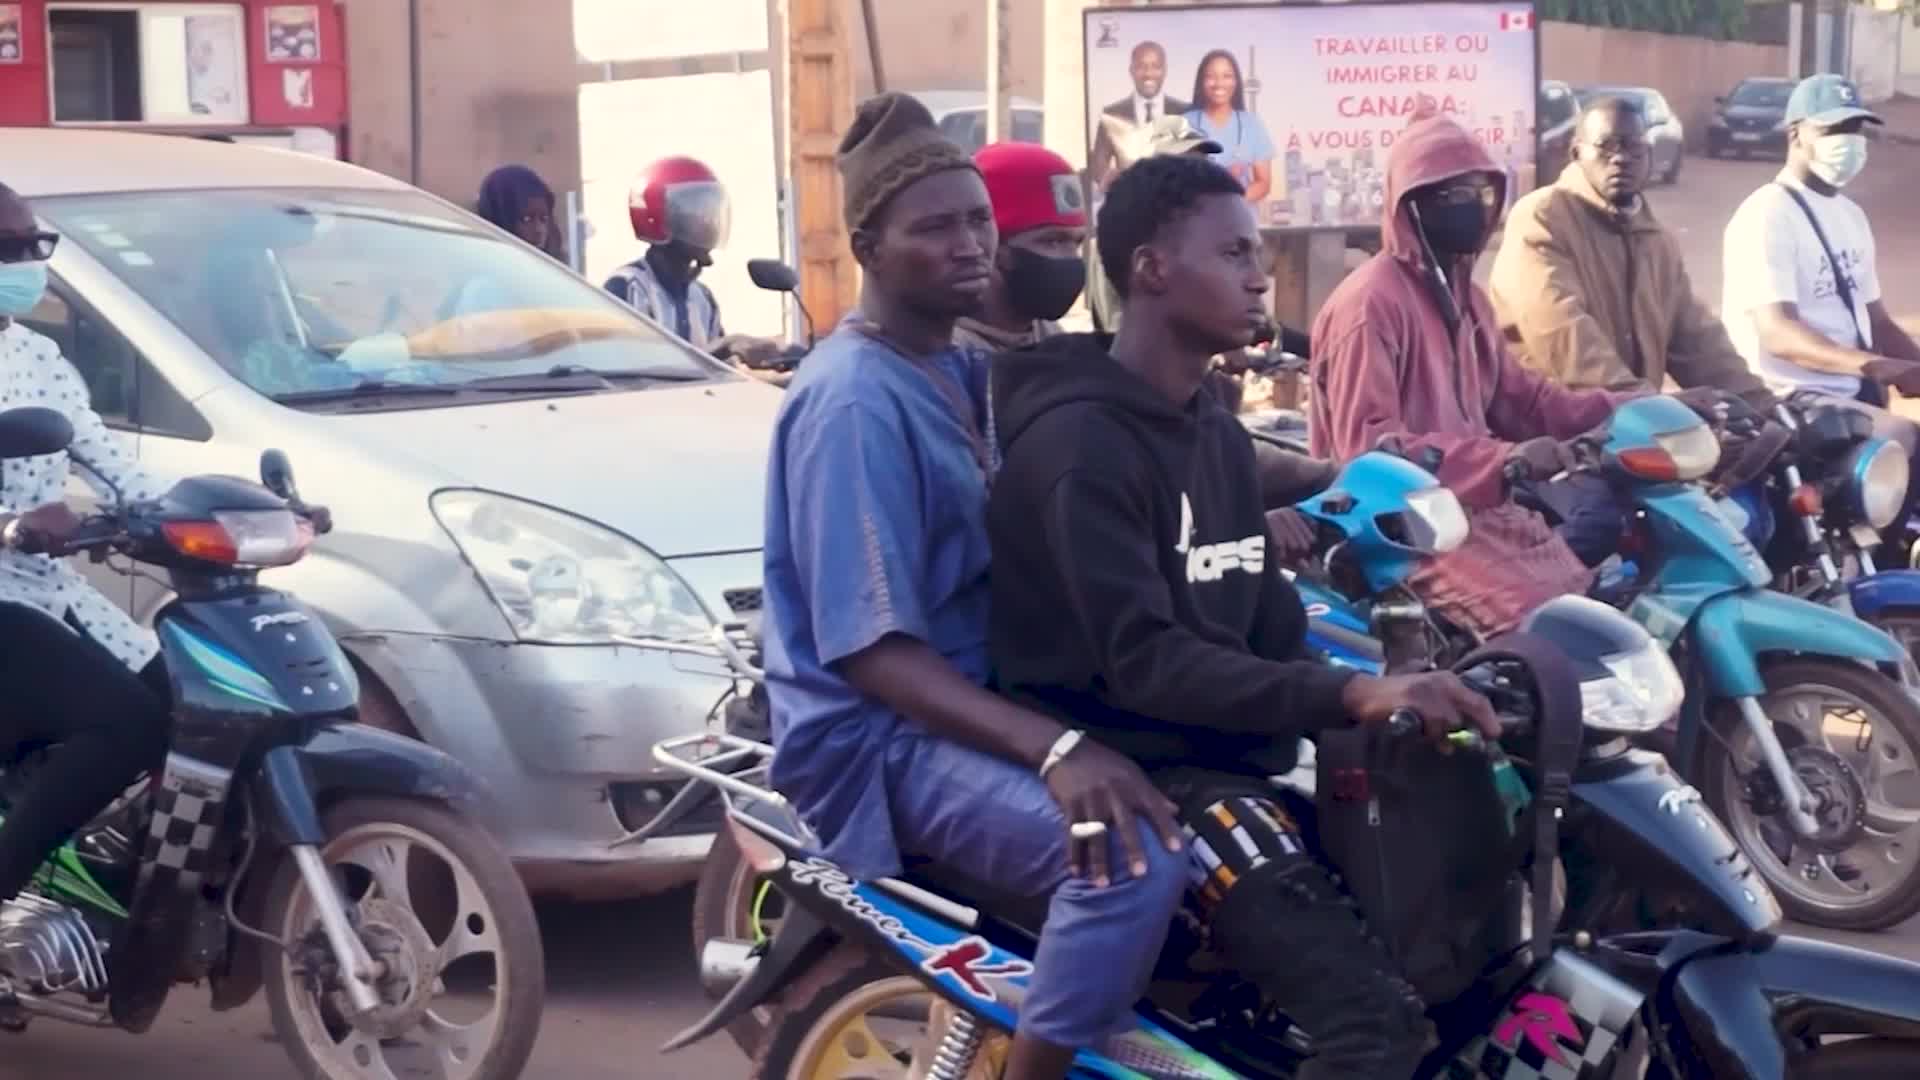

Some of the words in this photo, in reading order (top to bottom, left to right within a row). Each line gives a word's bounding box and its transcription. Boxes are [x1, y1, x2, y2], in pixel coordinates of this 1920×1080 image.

[1314, 35, 1448, 56] TRAVAILLER
[1455, 35, 1489, 53] OU
[1327, 64, 1439, 84] IMMIGRER
[1447, 64, 1478, 82] AU
[1308, 129, 1373, 149] VOUS
